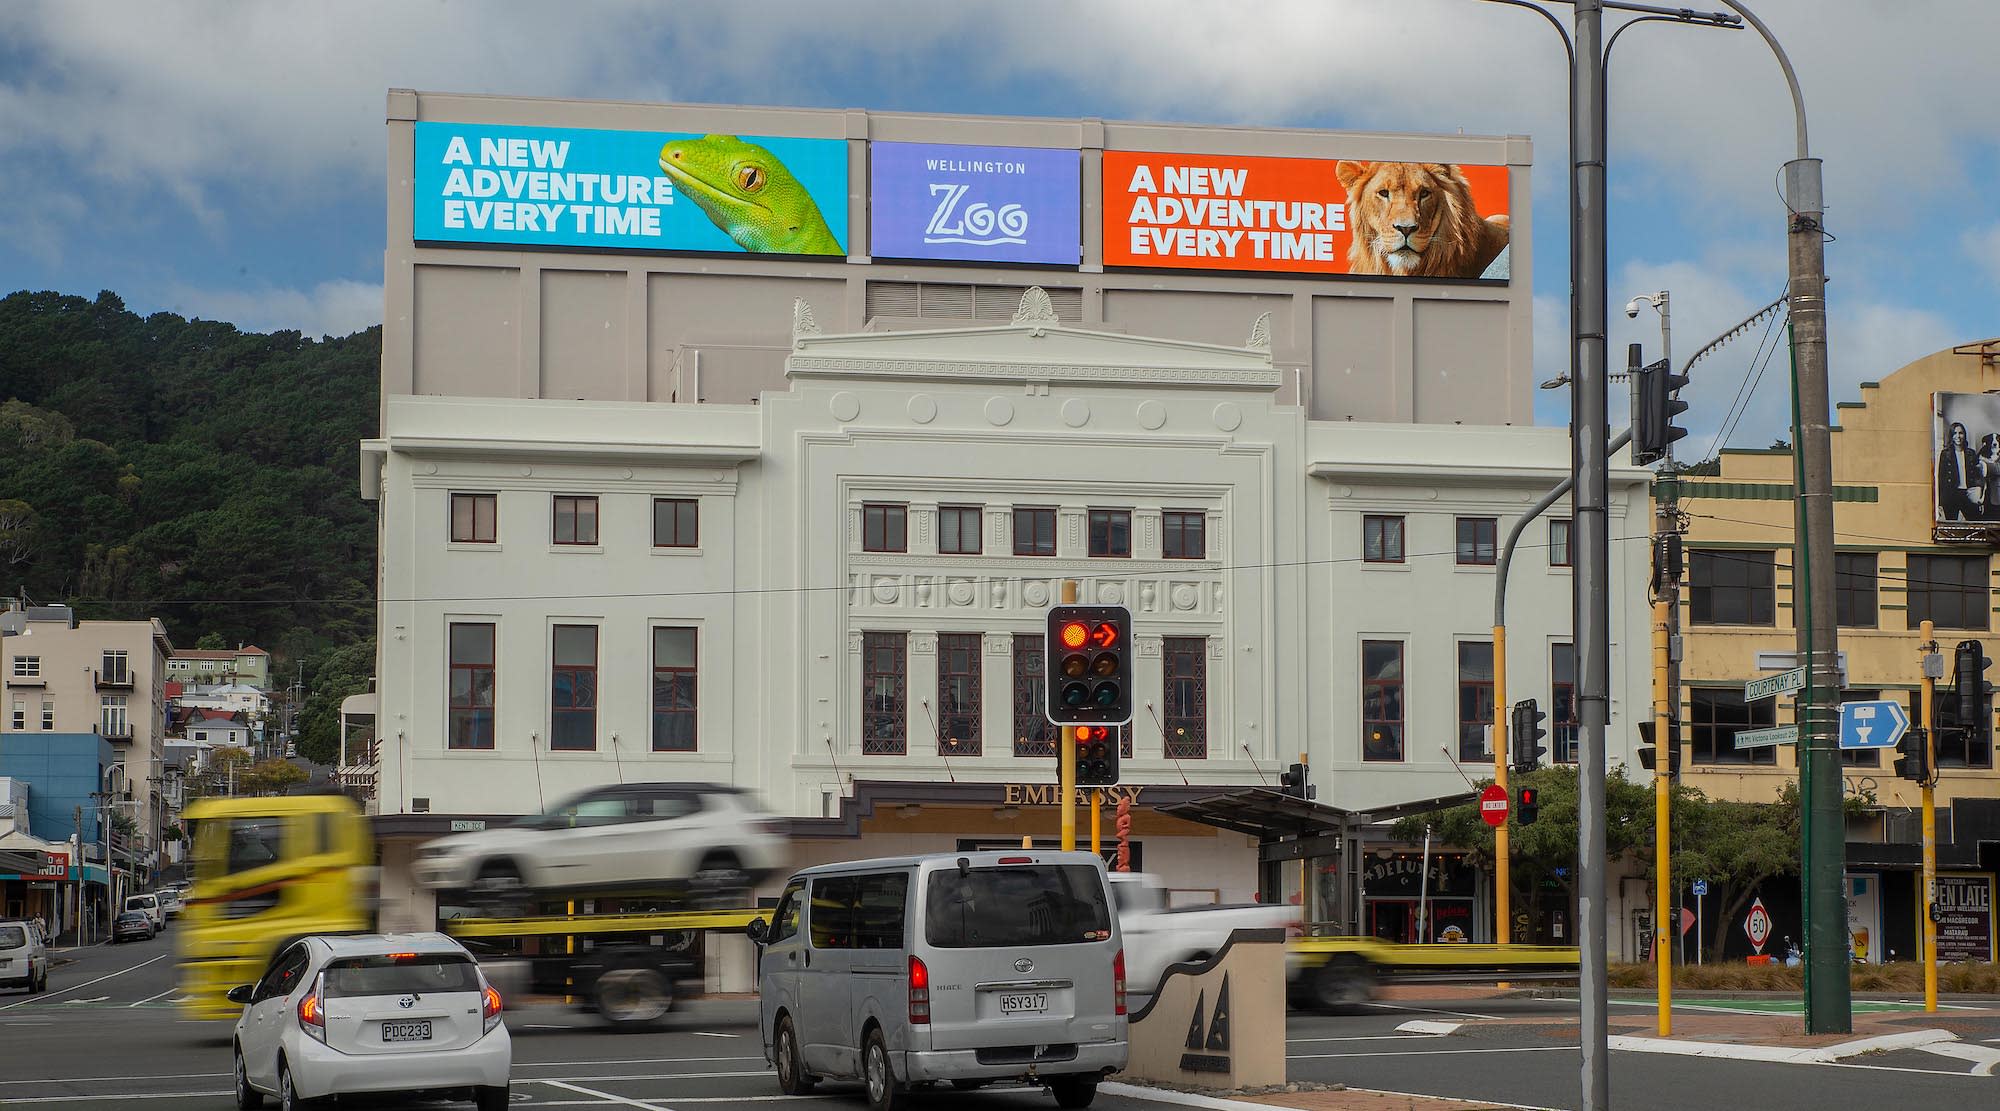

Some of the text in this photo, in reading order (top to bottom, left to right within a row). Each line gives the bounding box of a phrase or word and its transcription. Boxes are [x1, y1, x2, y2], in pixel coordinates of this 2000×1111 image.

[442, 136, 570, 169] A NEW
[926, 159, 1026, 174] WELLINGTON
[442, 168, 674, 205] ADVENTURE
[1127, 165, 1248, 197] A NEW
[443, 200, 662, 237] EVERY TIME
[925, 183, 1029, 237] Zoo
[1127, 196, 1346, 231] ADVENTURE
[1130, 226, 1334, 262] EVERY TIME
[1749, 672, 1801, 698] COURTENAY PL
[1752, 733, 1769, 743] Victoria
[1769, 731, 1788, 741] Lookout
[471, 822, 482, 830] TCE
[1959, 885, 1989, 906] LATE
[1752, 918, 1765, 934] 50
[1002, 995, 1046, 1010] HSY317
[384, 1024, 430, 1038] PDC233
